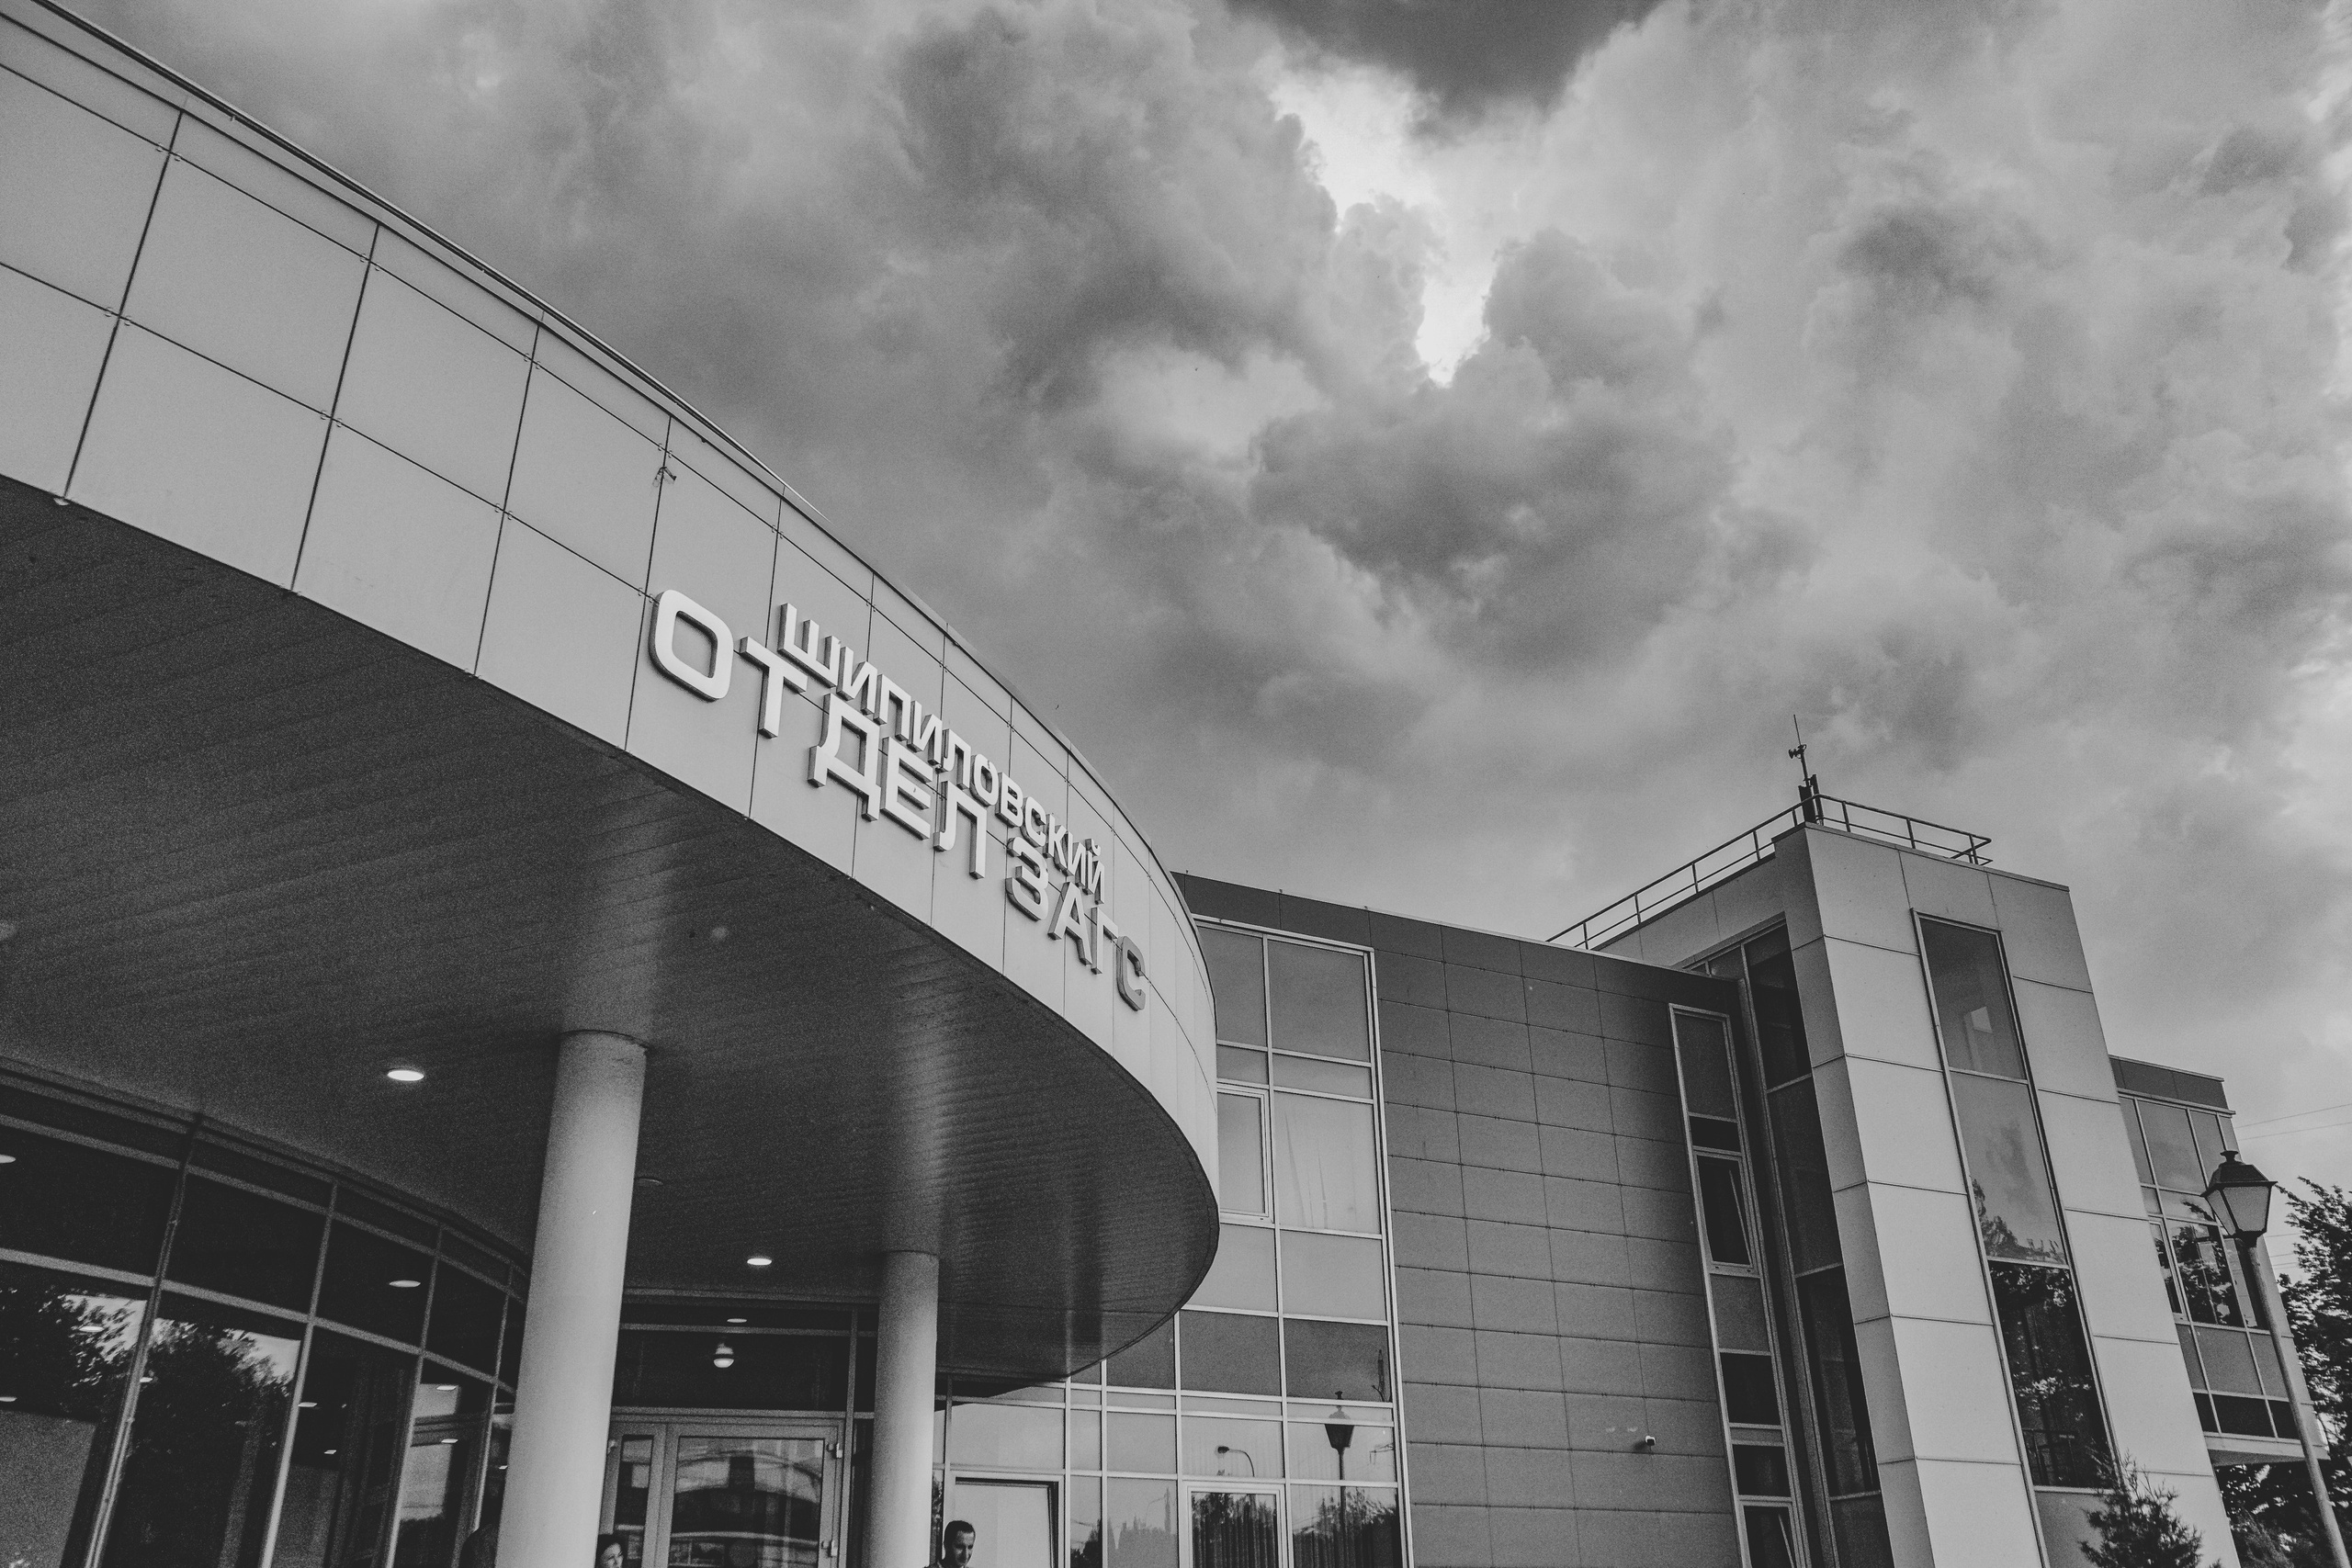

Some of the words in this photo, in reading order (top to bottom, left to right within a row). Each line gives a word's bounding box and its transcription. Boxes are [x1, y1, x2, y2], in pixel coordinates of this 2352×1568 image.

[649, 589, 988, 879] ОТДЕЛ
[1005, 836, 1147, 1011] ЗАГС
[777, 603, 1104, 904] ШИПИЛОВСКИЙ
